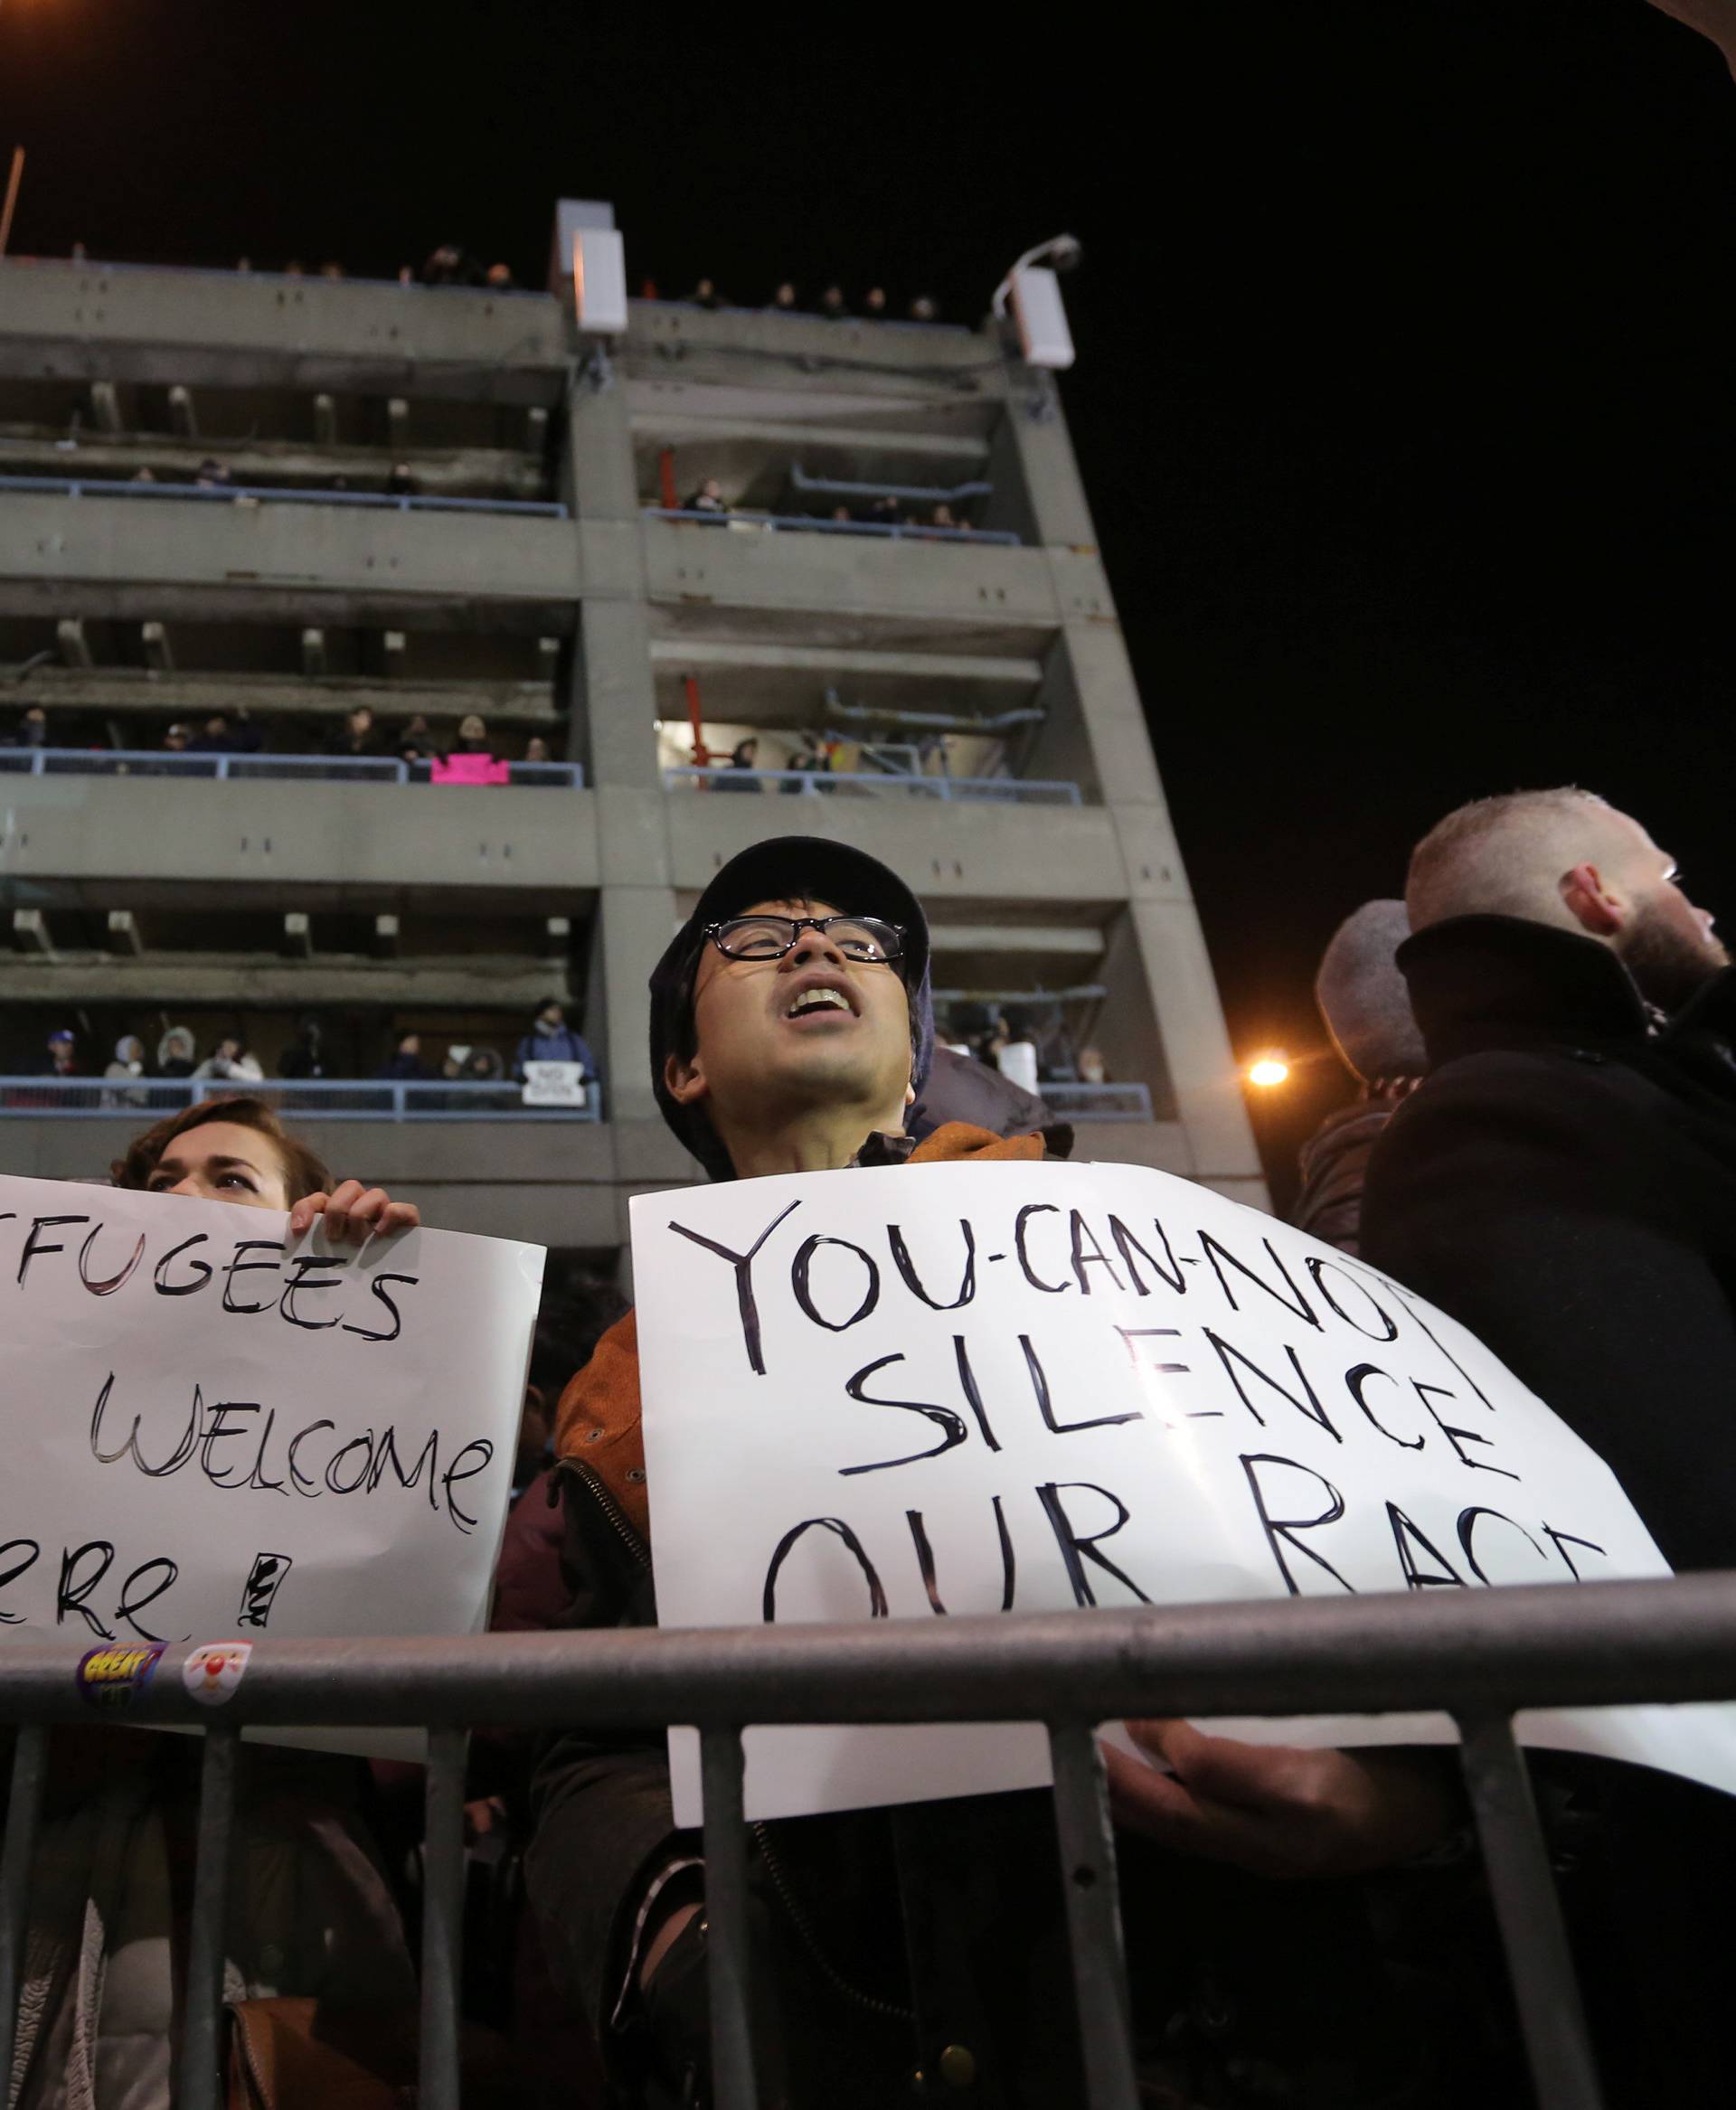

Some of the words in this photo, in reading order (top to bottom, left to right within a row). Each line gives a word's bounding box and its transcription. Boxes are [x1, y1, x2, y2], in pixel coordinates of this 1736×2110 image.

[0, 1212, 420, 1342] FUGEES
[837, 1325, 1521, 1482] SILENCE
[762, 1483, 1153, 1625] OUR
